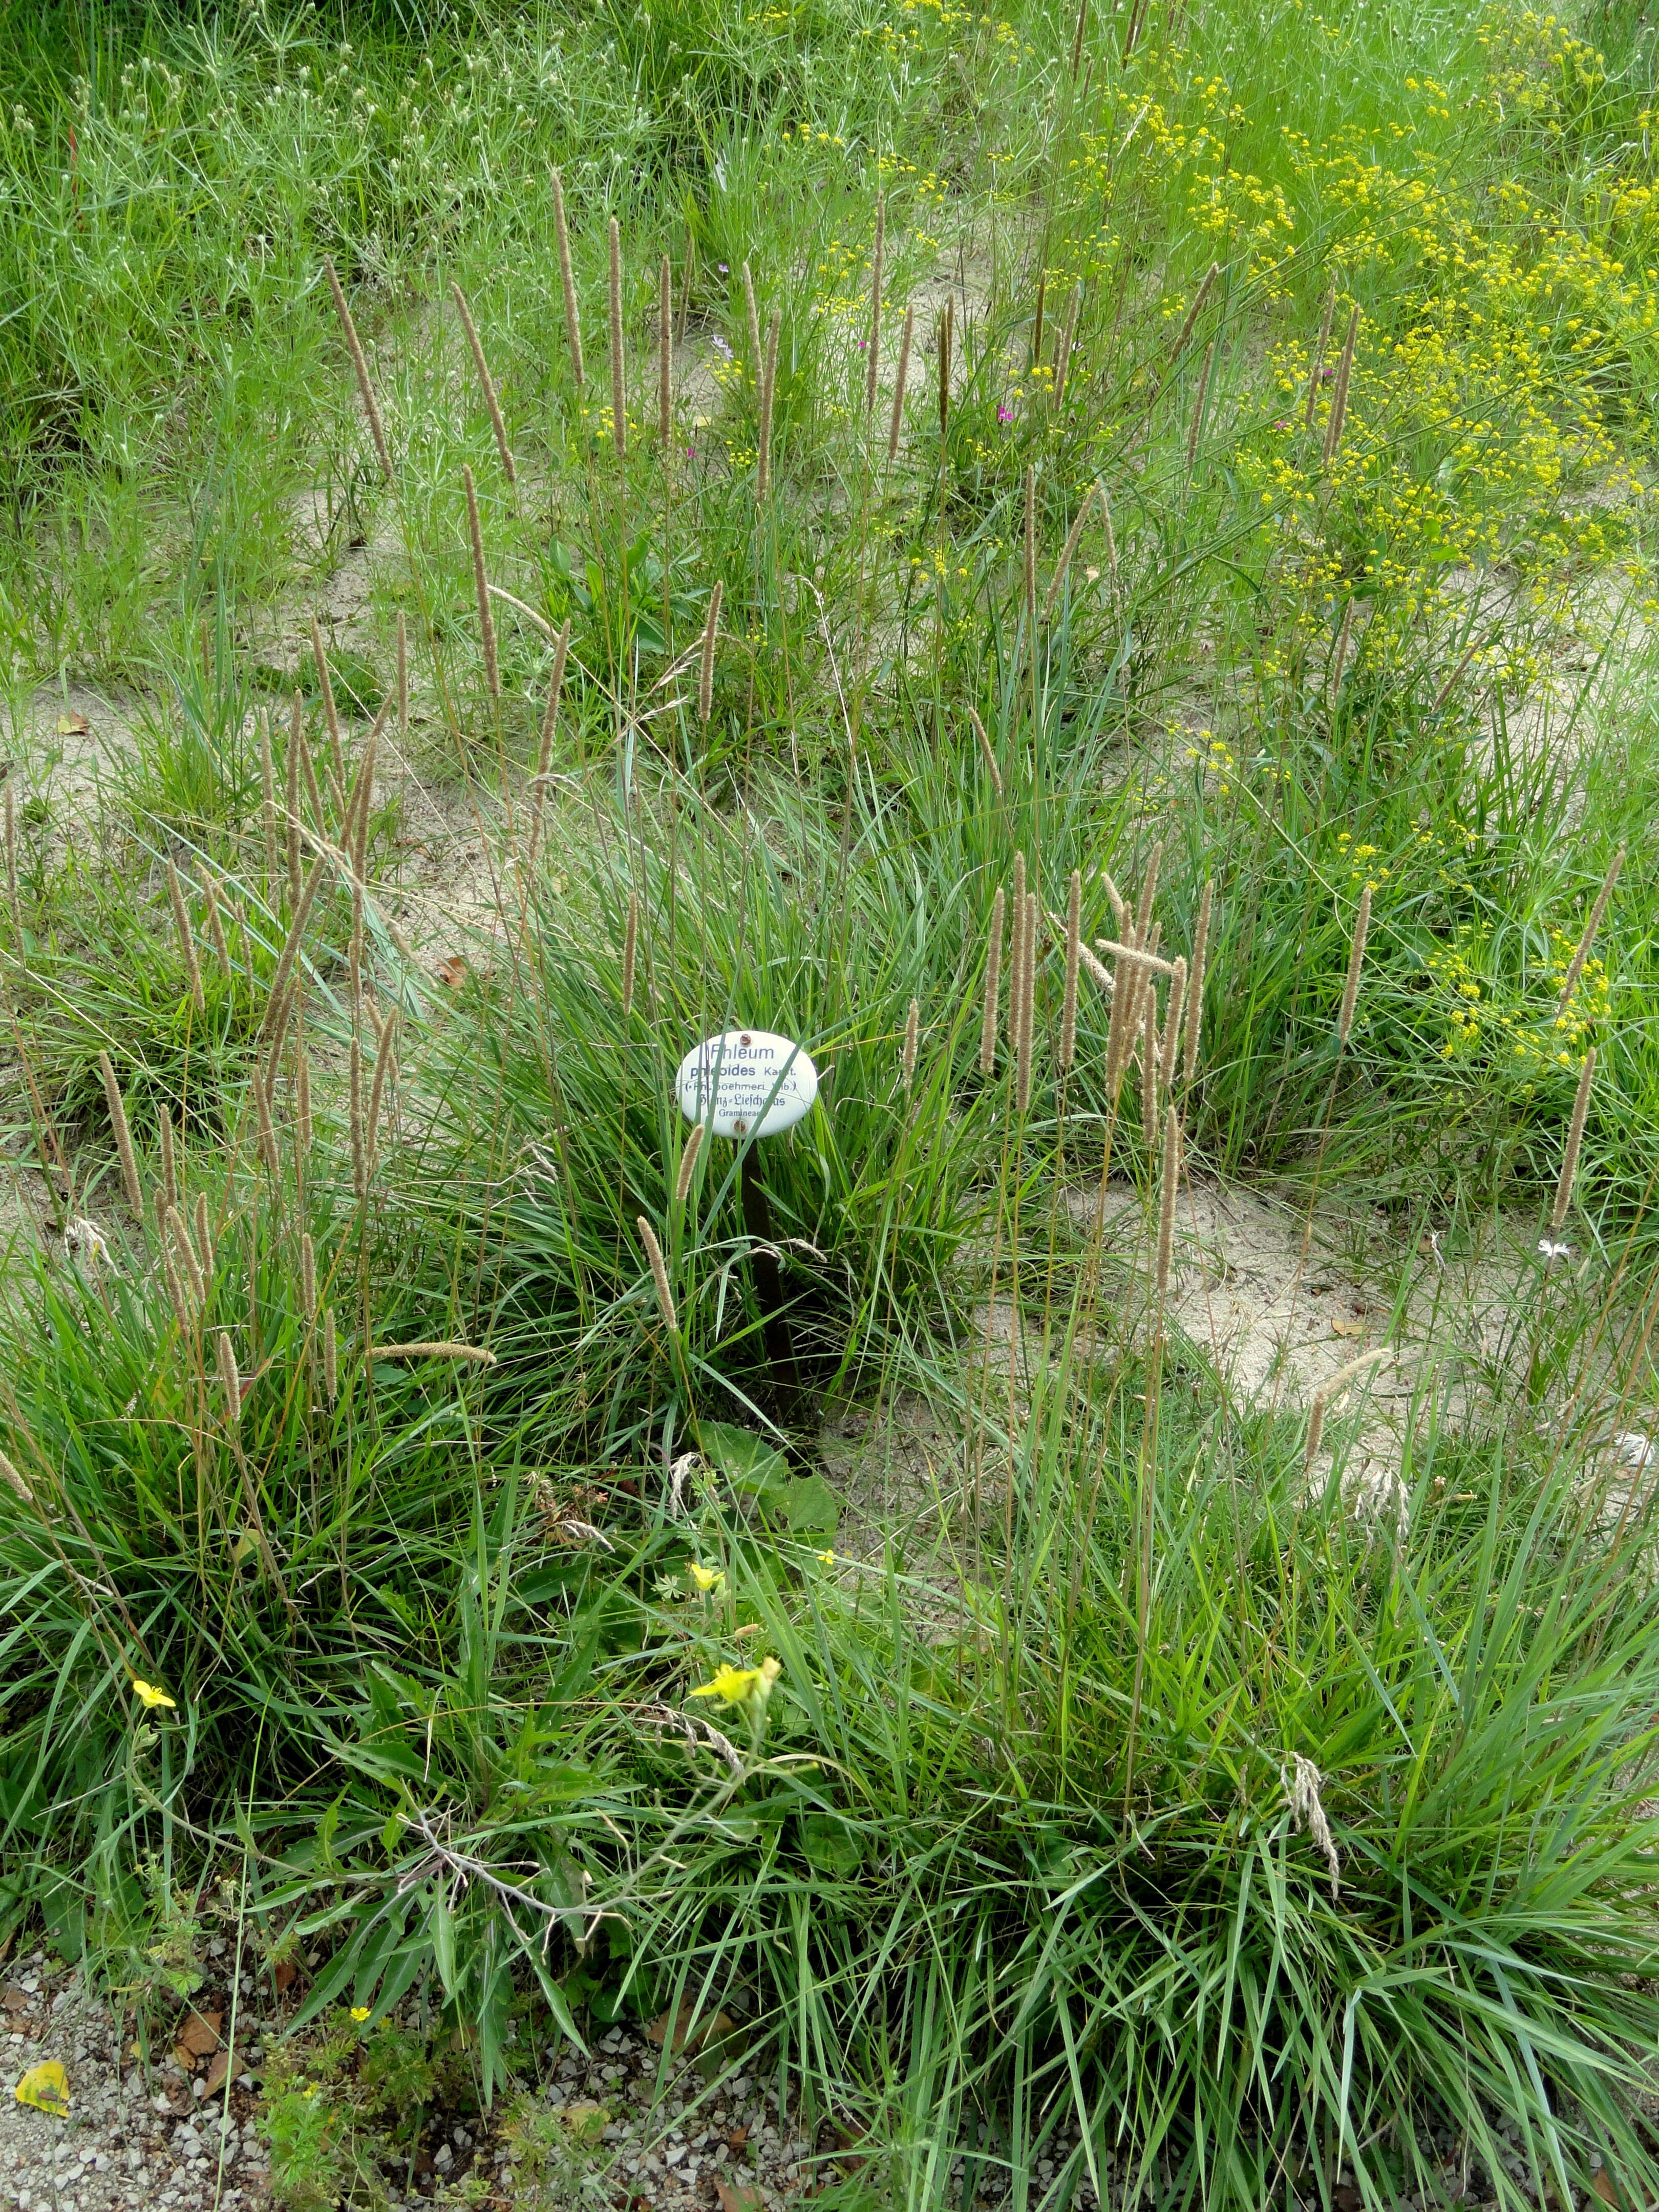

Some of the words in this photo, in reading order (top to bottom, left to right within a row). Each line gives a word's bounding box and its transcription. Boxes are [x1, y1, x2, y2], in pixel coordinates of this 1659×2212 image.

[711, 1044, 774, 1059] Phleum
[690, 1064, 756, 1079] pheoides
[764, 1067, 796, 1076] Kat.
